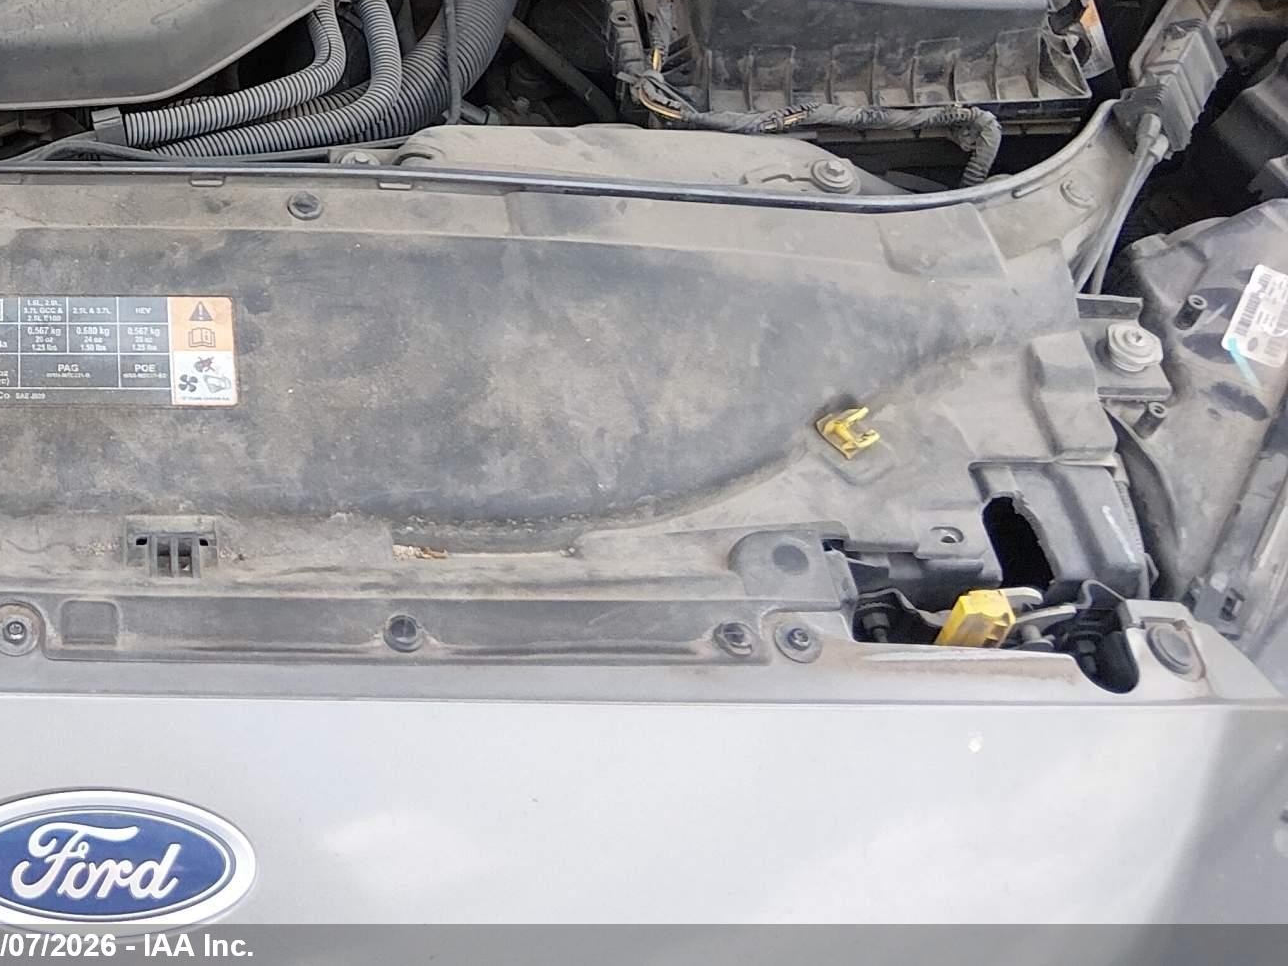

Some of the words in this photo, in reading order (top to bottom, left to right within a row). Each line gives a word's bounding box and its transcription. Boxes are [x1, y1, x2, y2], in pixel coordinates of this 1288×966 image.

[50, 326, 61, 337] kg
[99, 326, 110, 337] kg
[150, 326, 161, 337] kg
[57, 364, 80, 372] PAG
[134, 364, 156, 372] POE
[11, 822, 181, 902] Ford
